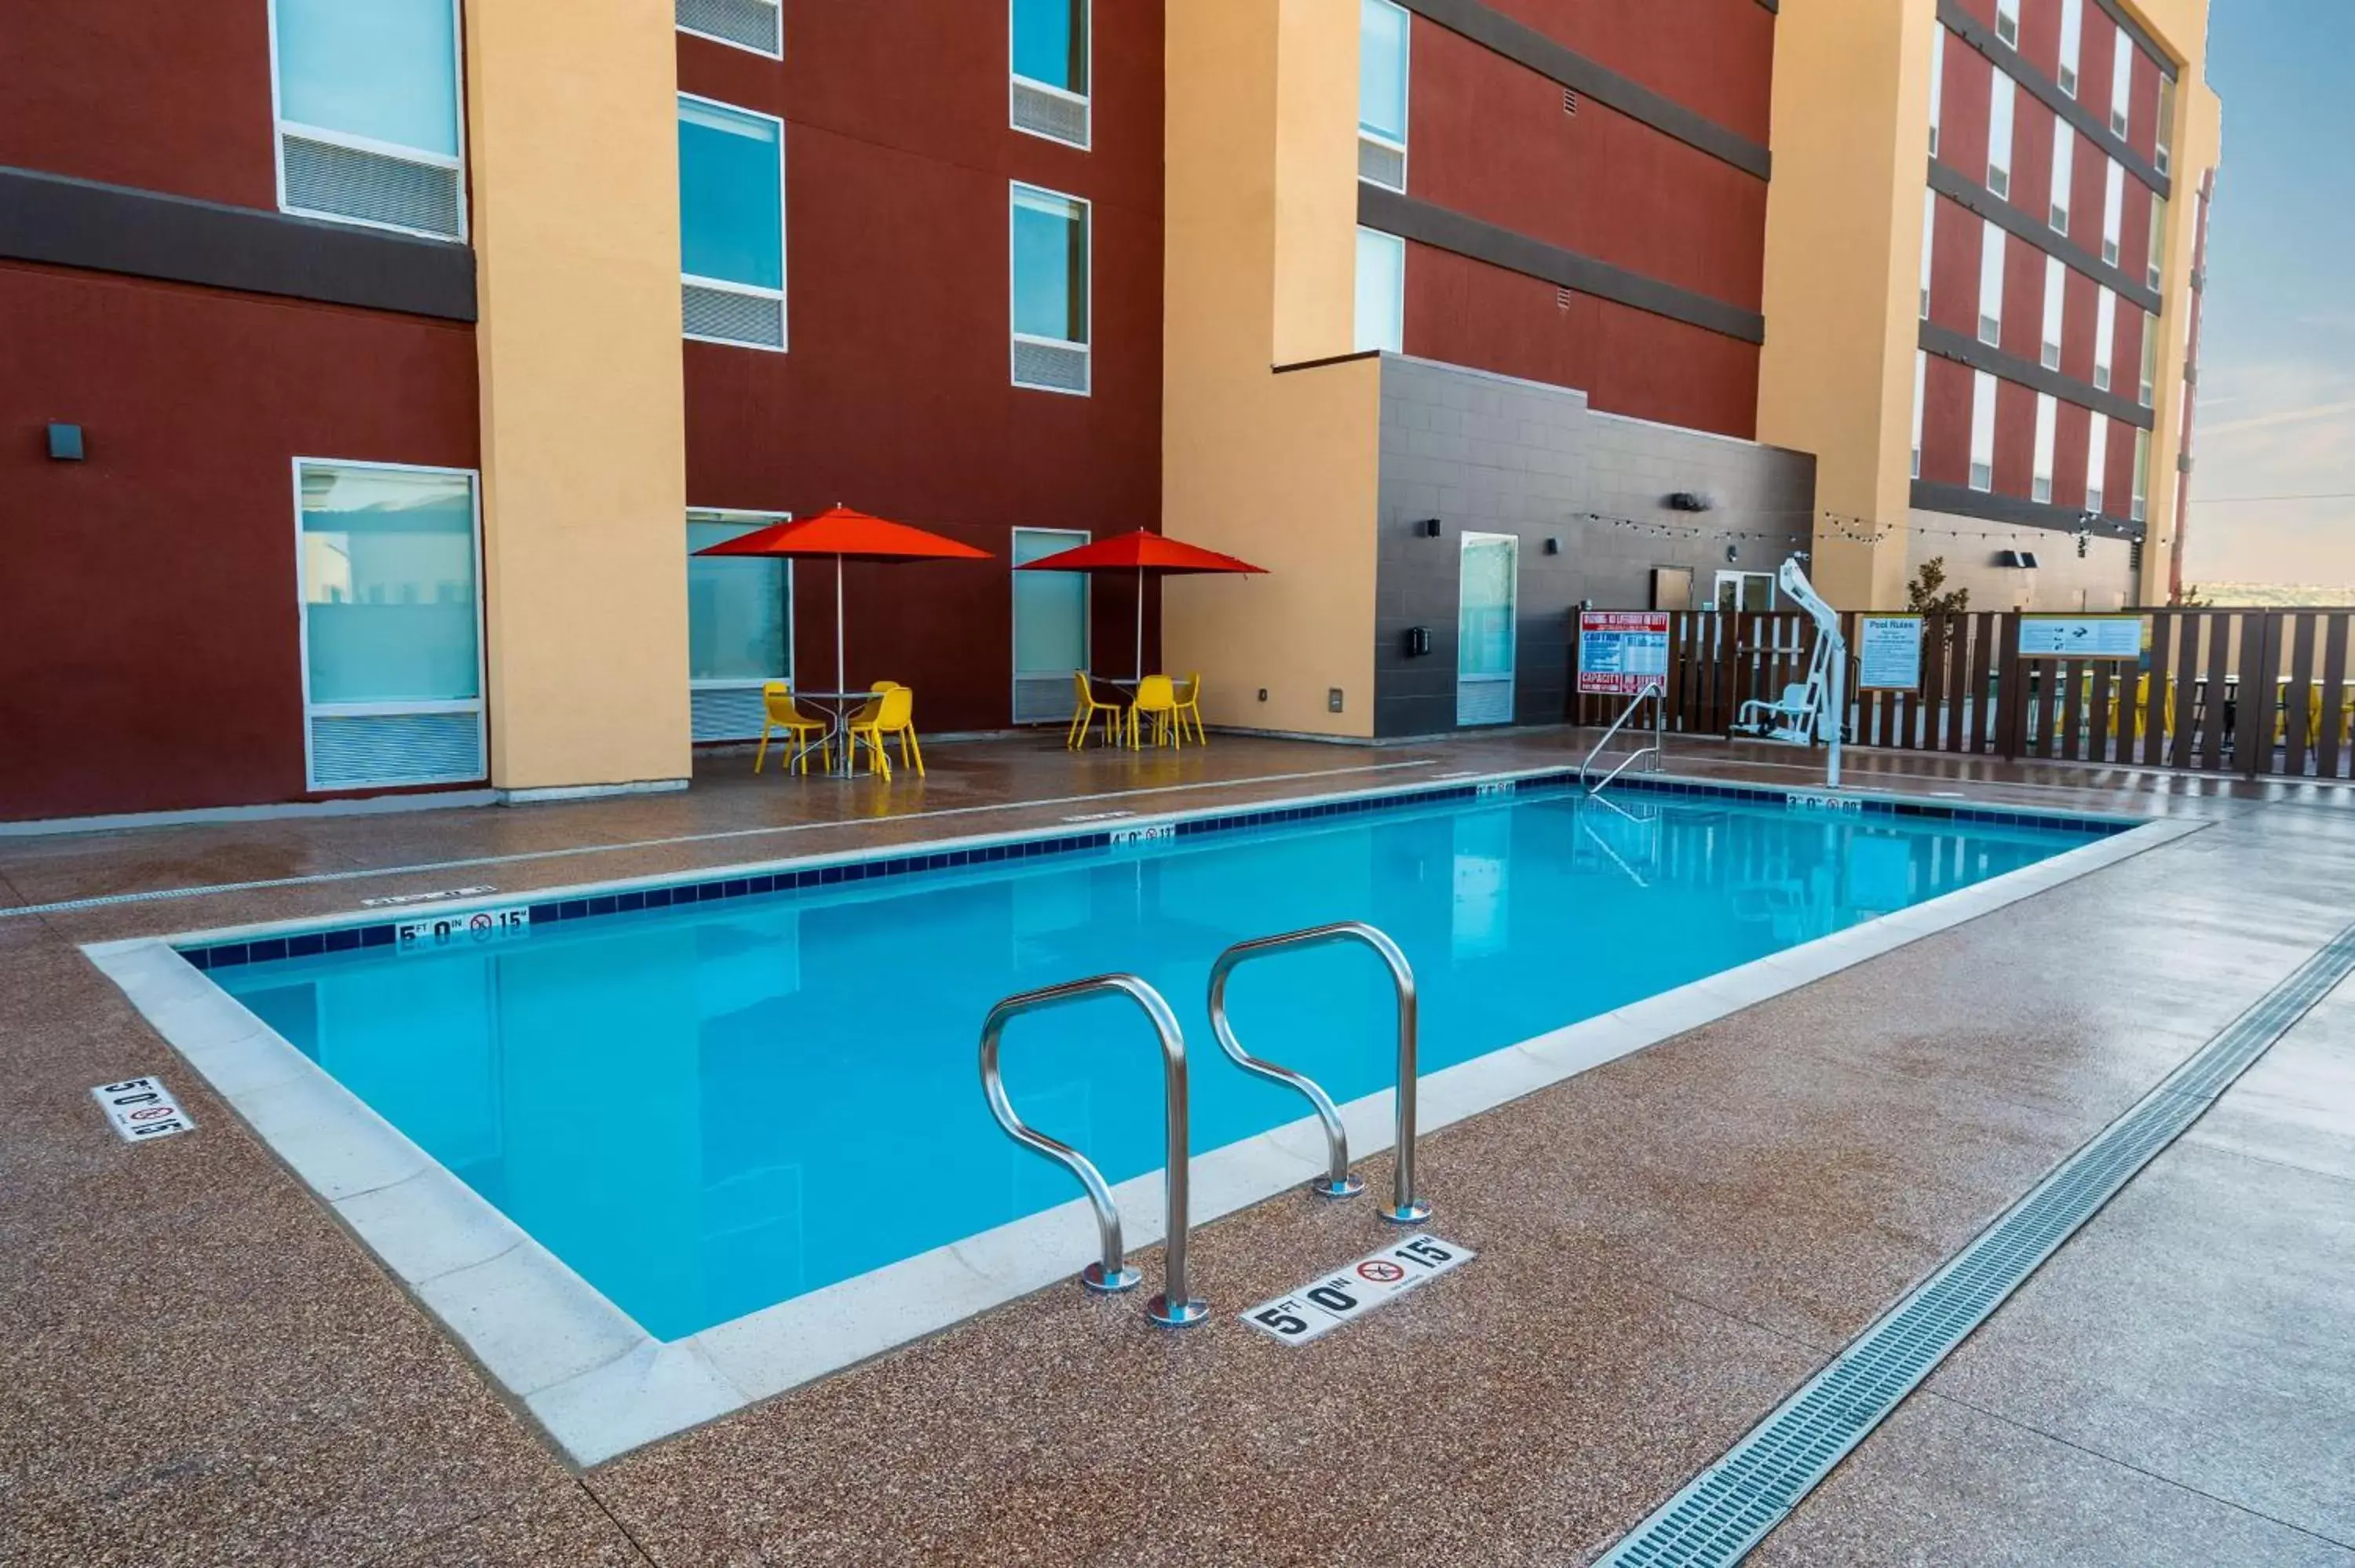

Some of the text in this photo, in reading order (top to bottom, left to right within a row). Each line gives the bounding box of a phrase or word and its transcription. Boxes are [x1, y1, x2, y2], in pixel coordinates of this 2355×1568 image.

[1869, 619, 1915, 629] Pool Rules
[1582, 673, 1619, 684] CAPACITY
[400, 925, 416, 939] 5
[1254, 1308, 1308, 1334] 5
